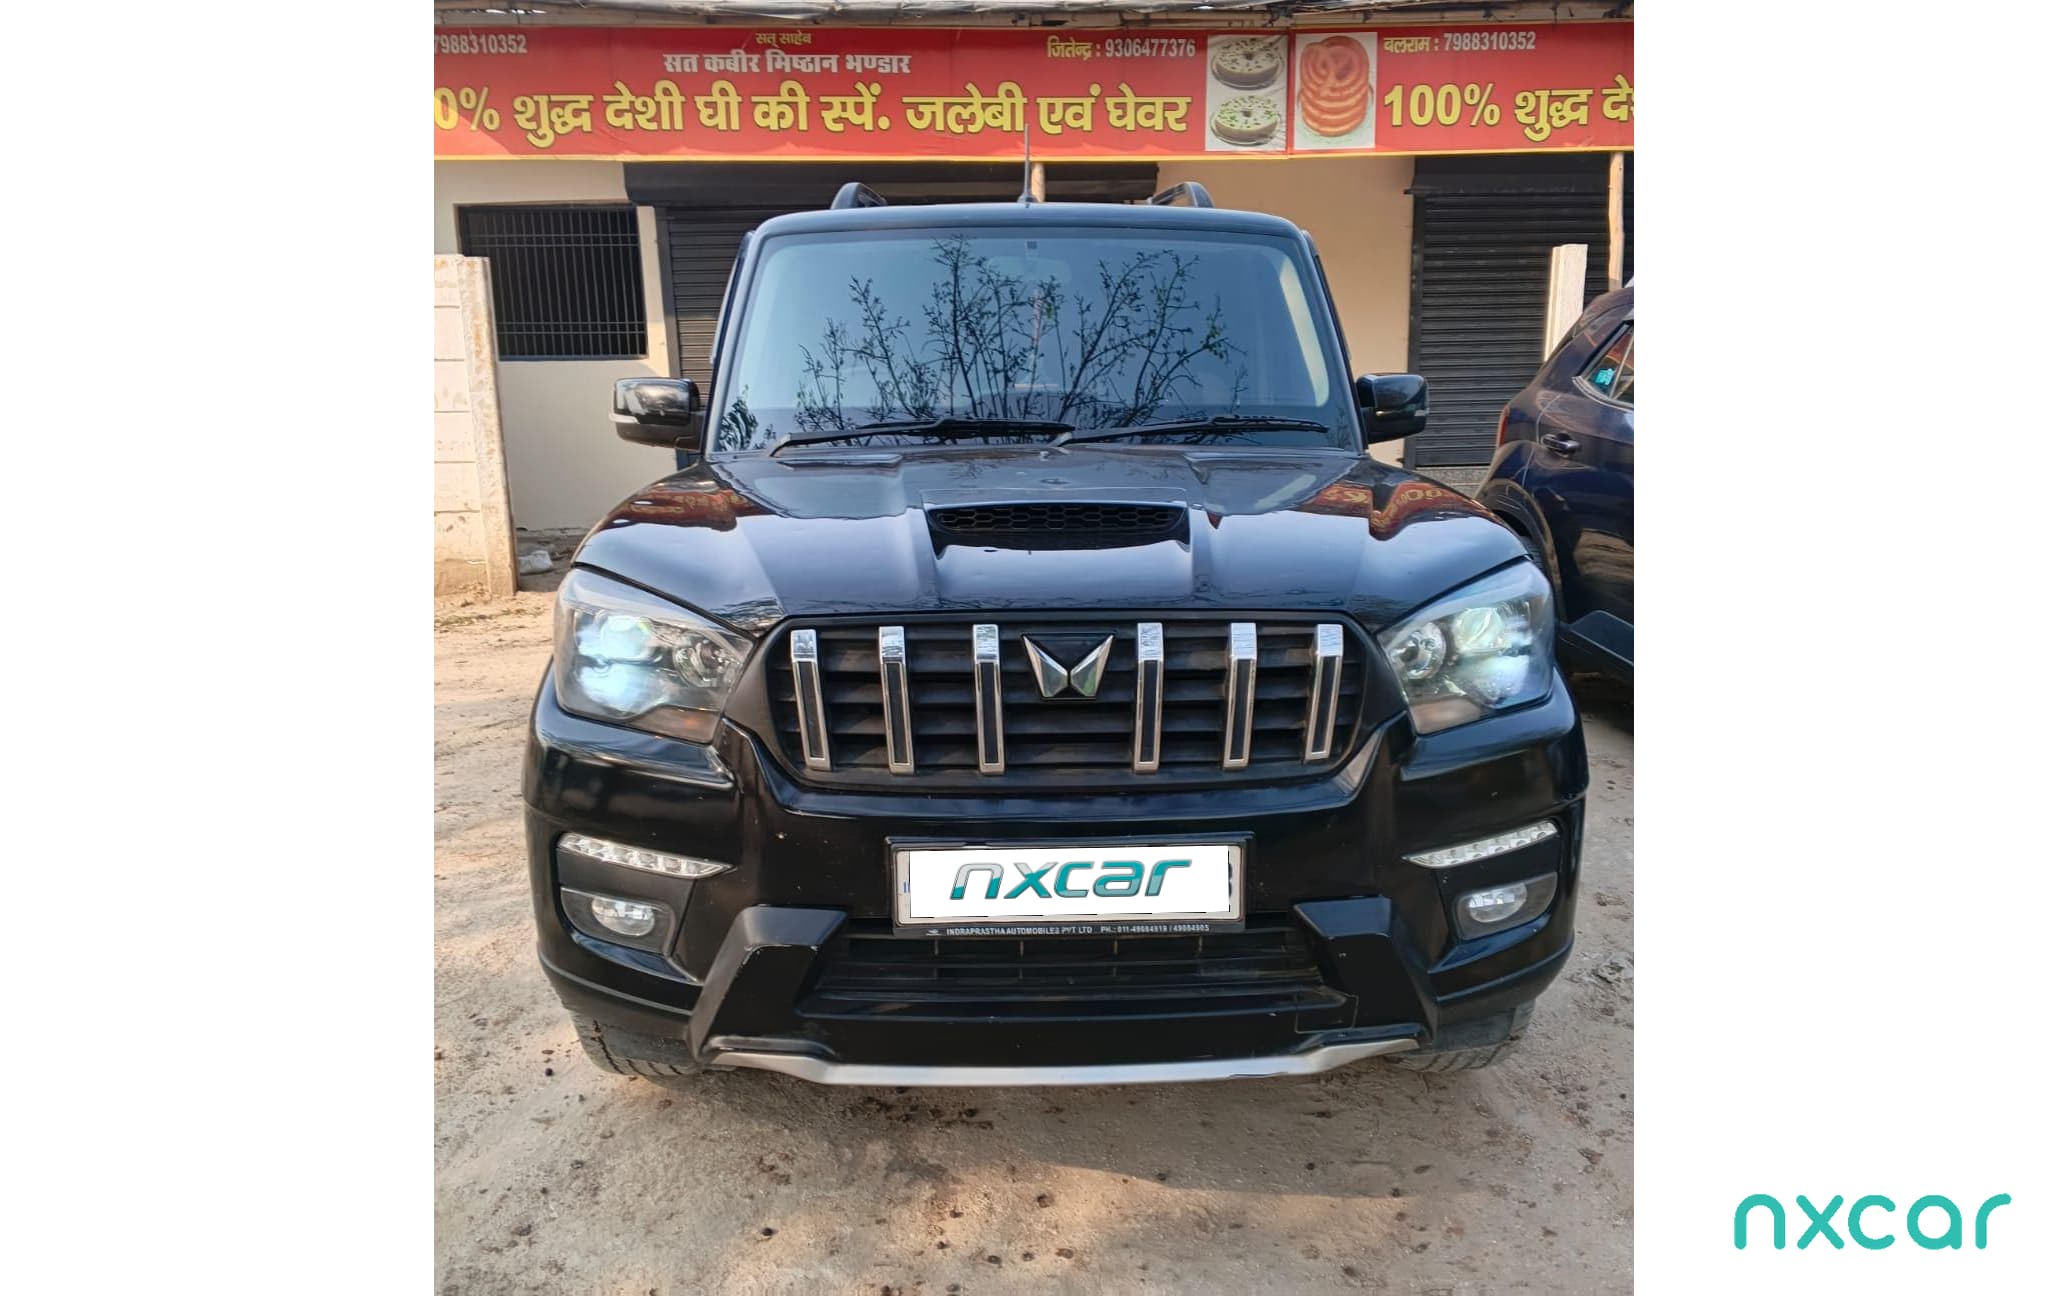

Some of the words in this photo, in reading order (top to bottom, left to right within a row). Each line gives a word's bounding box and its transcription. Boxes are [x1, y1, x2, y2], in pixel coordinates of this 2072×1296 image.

[1047, 35, 1093, 61] जितेन्द्र
[1105, 38, 1196, 57] 9306477376
[1443, 31, 1537, 51] 7988310352
[663, 54, 699, 73] सत
[702, 49, 761, 73] कबीर
[845, 54, 912, 74] भण्डार
[513, 94, 595, 149] शुद्ध
[602, 79, 686, 131] देशी
[694, 79, 742, 131] घी
[751, 79, 811, 131] की
[902, 82, 1027, 135] जलेबी
[1036, 82, 1102, 135] एवं
[1105, 82, 1192, 133] घेवर
[1384, 83, 1500, 127] 100%
[1514, 89, 1594, 142] शुद्ध
